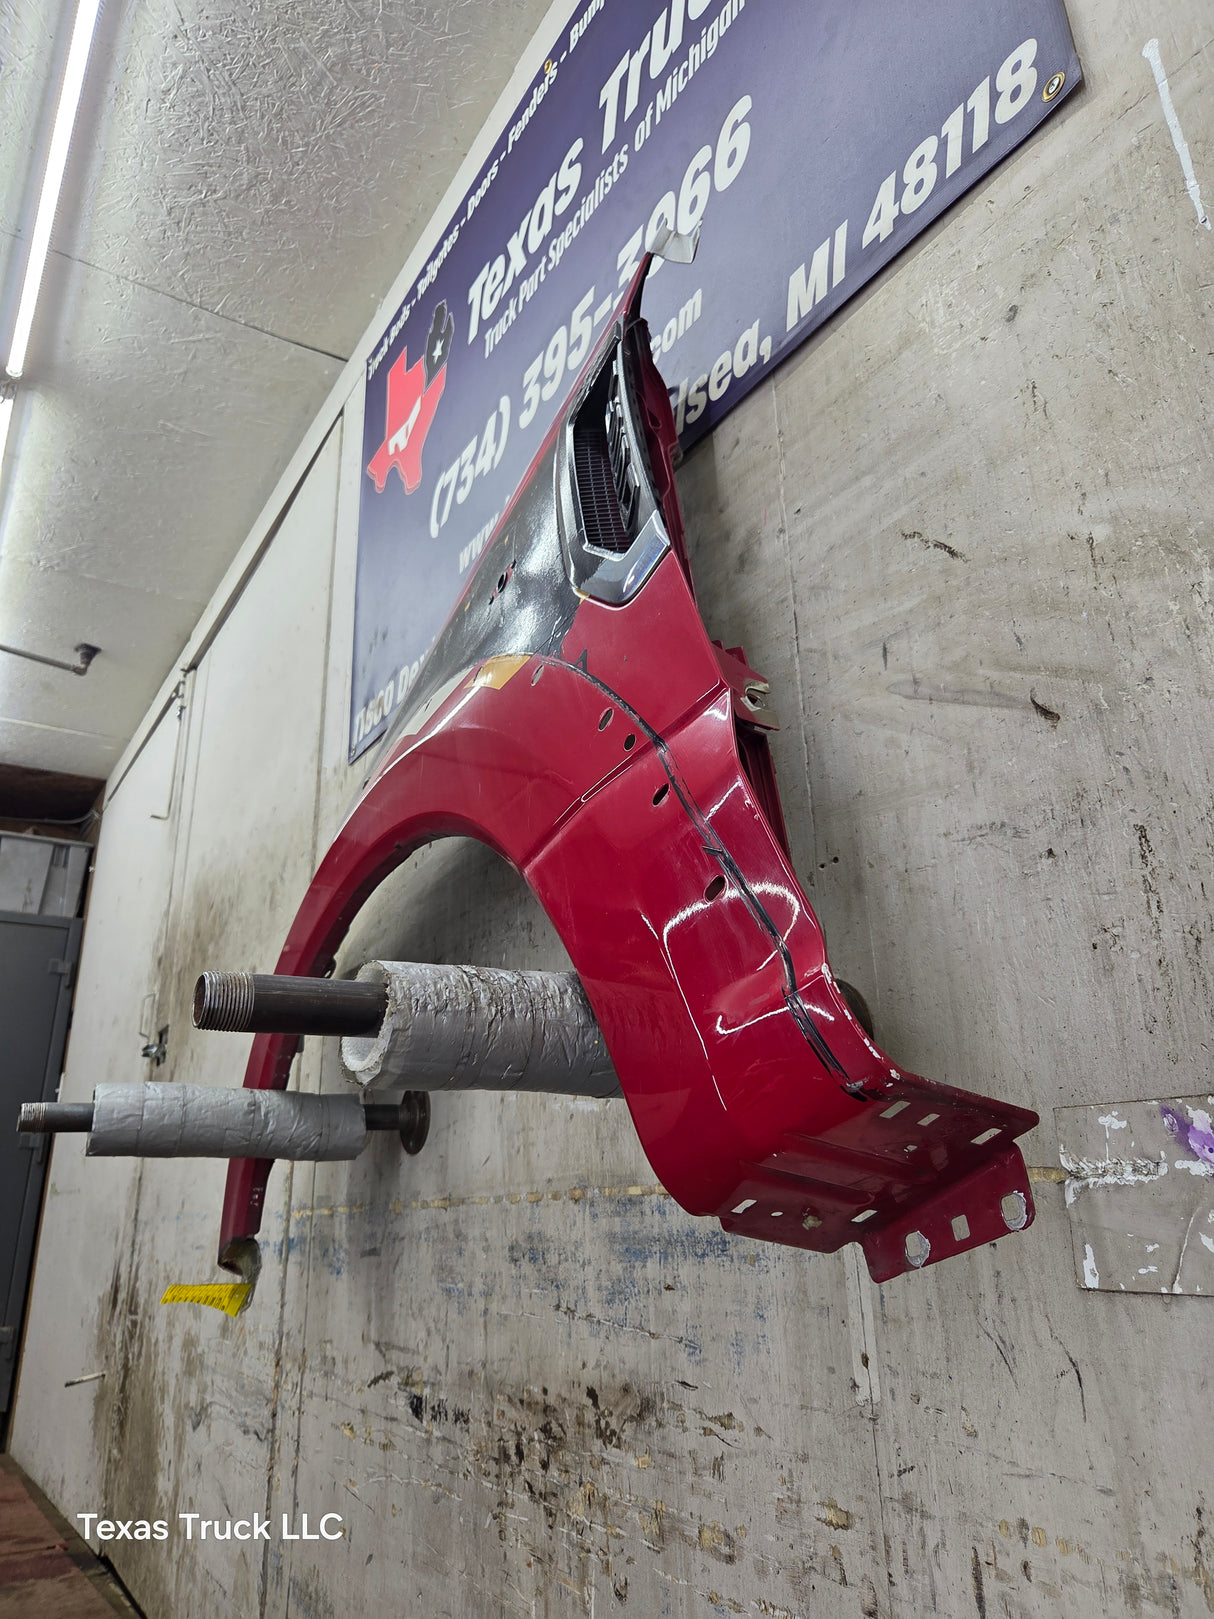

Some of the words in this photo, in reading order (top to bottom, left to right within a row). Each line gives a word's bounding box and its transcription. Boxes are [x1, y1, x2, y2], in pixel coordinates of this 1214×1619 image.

[467, 159, 499, 220] Doors
[508, 61, 558, 153] Fenders
[569, 0, 606, 53] Bum
[467, 138, 583, 346] Texas
[599, 0, 712, 155] Tru
[484, 297, 518, 359] Truck
[518, 256, 547, 313] Part
[548, 144, 628, 271] Specialists
[635, 101, 653, 152] of
[656, 0, 745, 125] Michigan
[669, 318, 772, 436] lsea,
[786, 219, 848, 332] MI
[862, 38, 1038, 248] 48118
[430, 395, 511, 538] (734)
